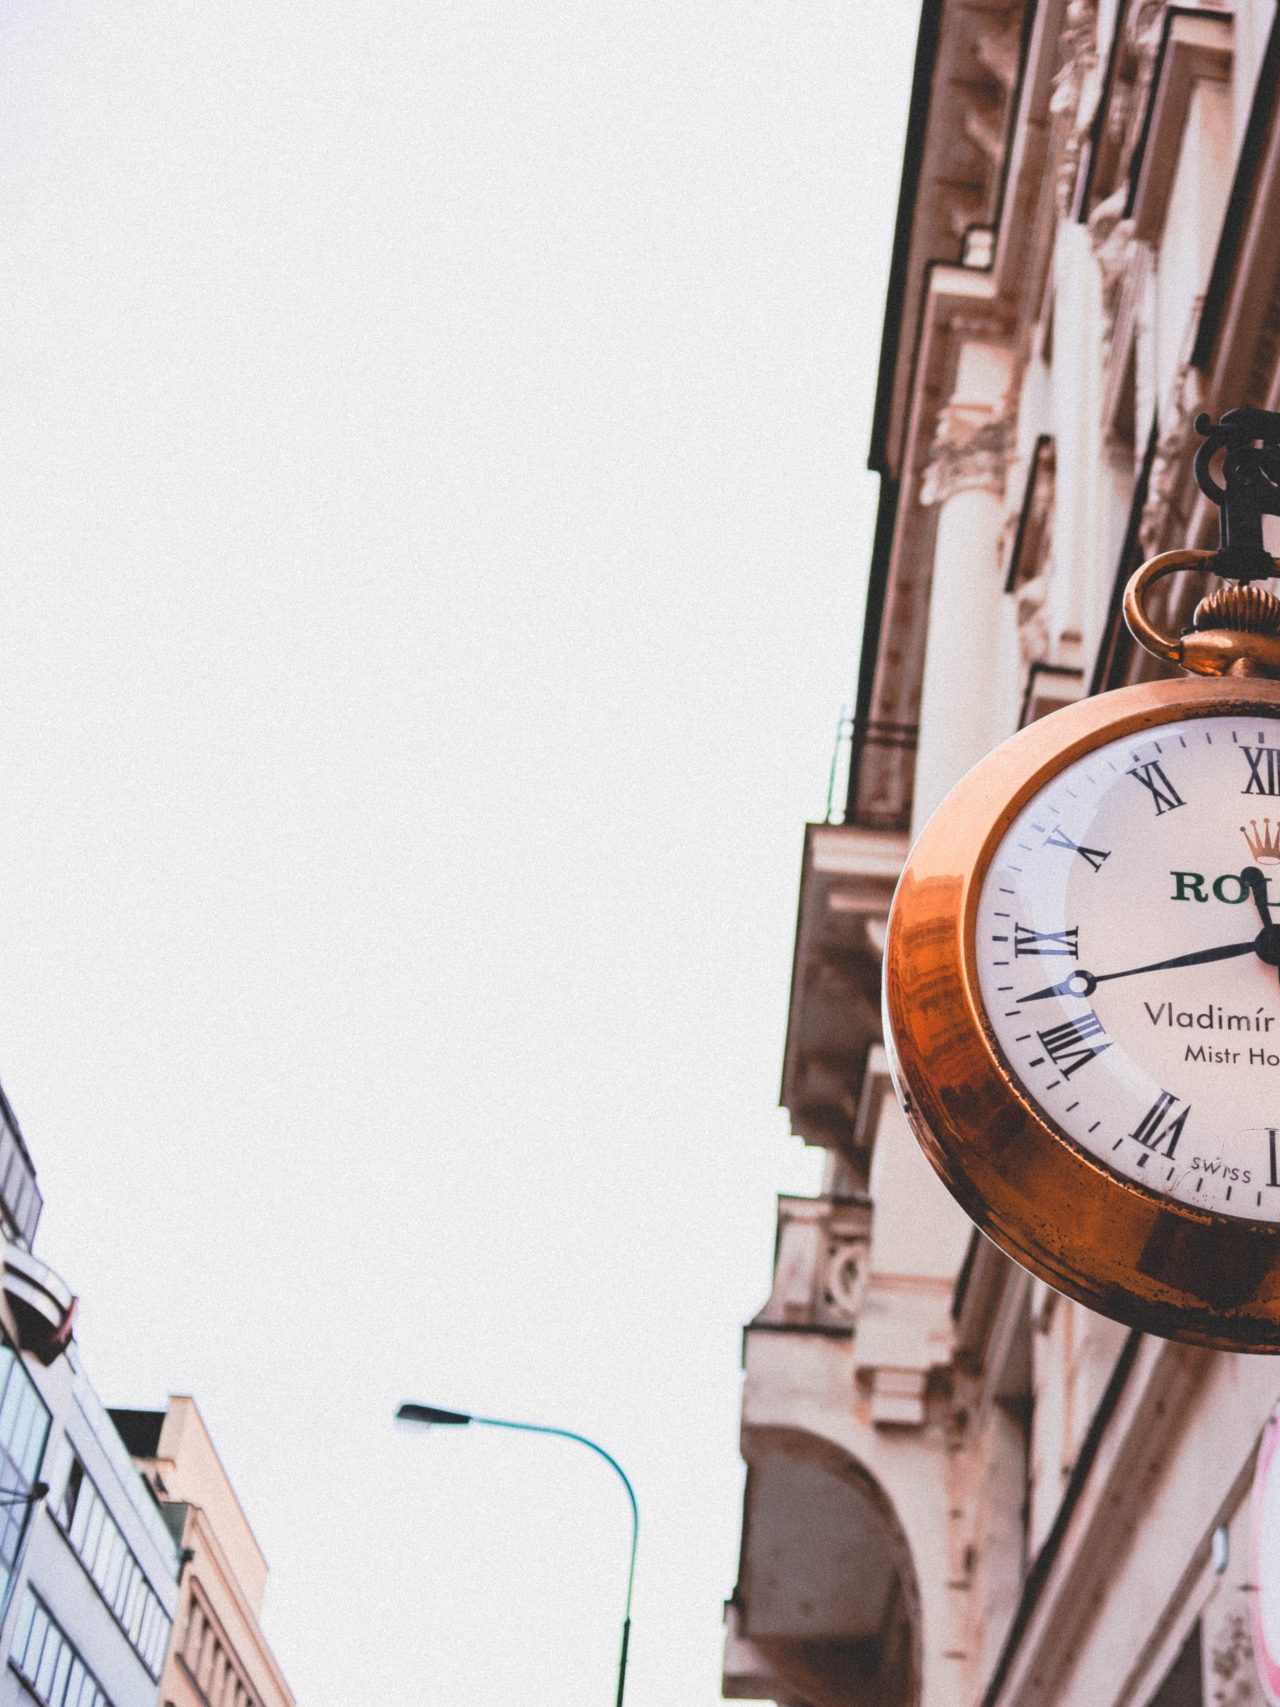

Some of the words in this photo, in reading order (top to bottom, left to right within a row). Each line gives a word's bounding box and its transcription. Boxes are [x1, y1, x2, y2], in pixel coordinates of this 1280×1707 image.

[1126, 760, 1187, 816] XI
[1043, 825, 1111, 873] X
[1015, 922, 1079, 960] IX
[1144, 1002, 1275, 1033] Vladimír
[1184, 1044, 1240, 1064] Mistr
[1191, 1156, 1251, 1183] SWISS
